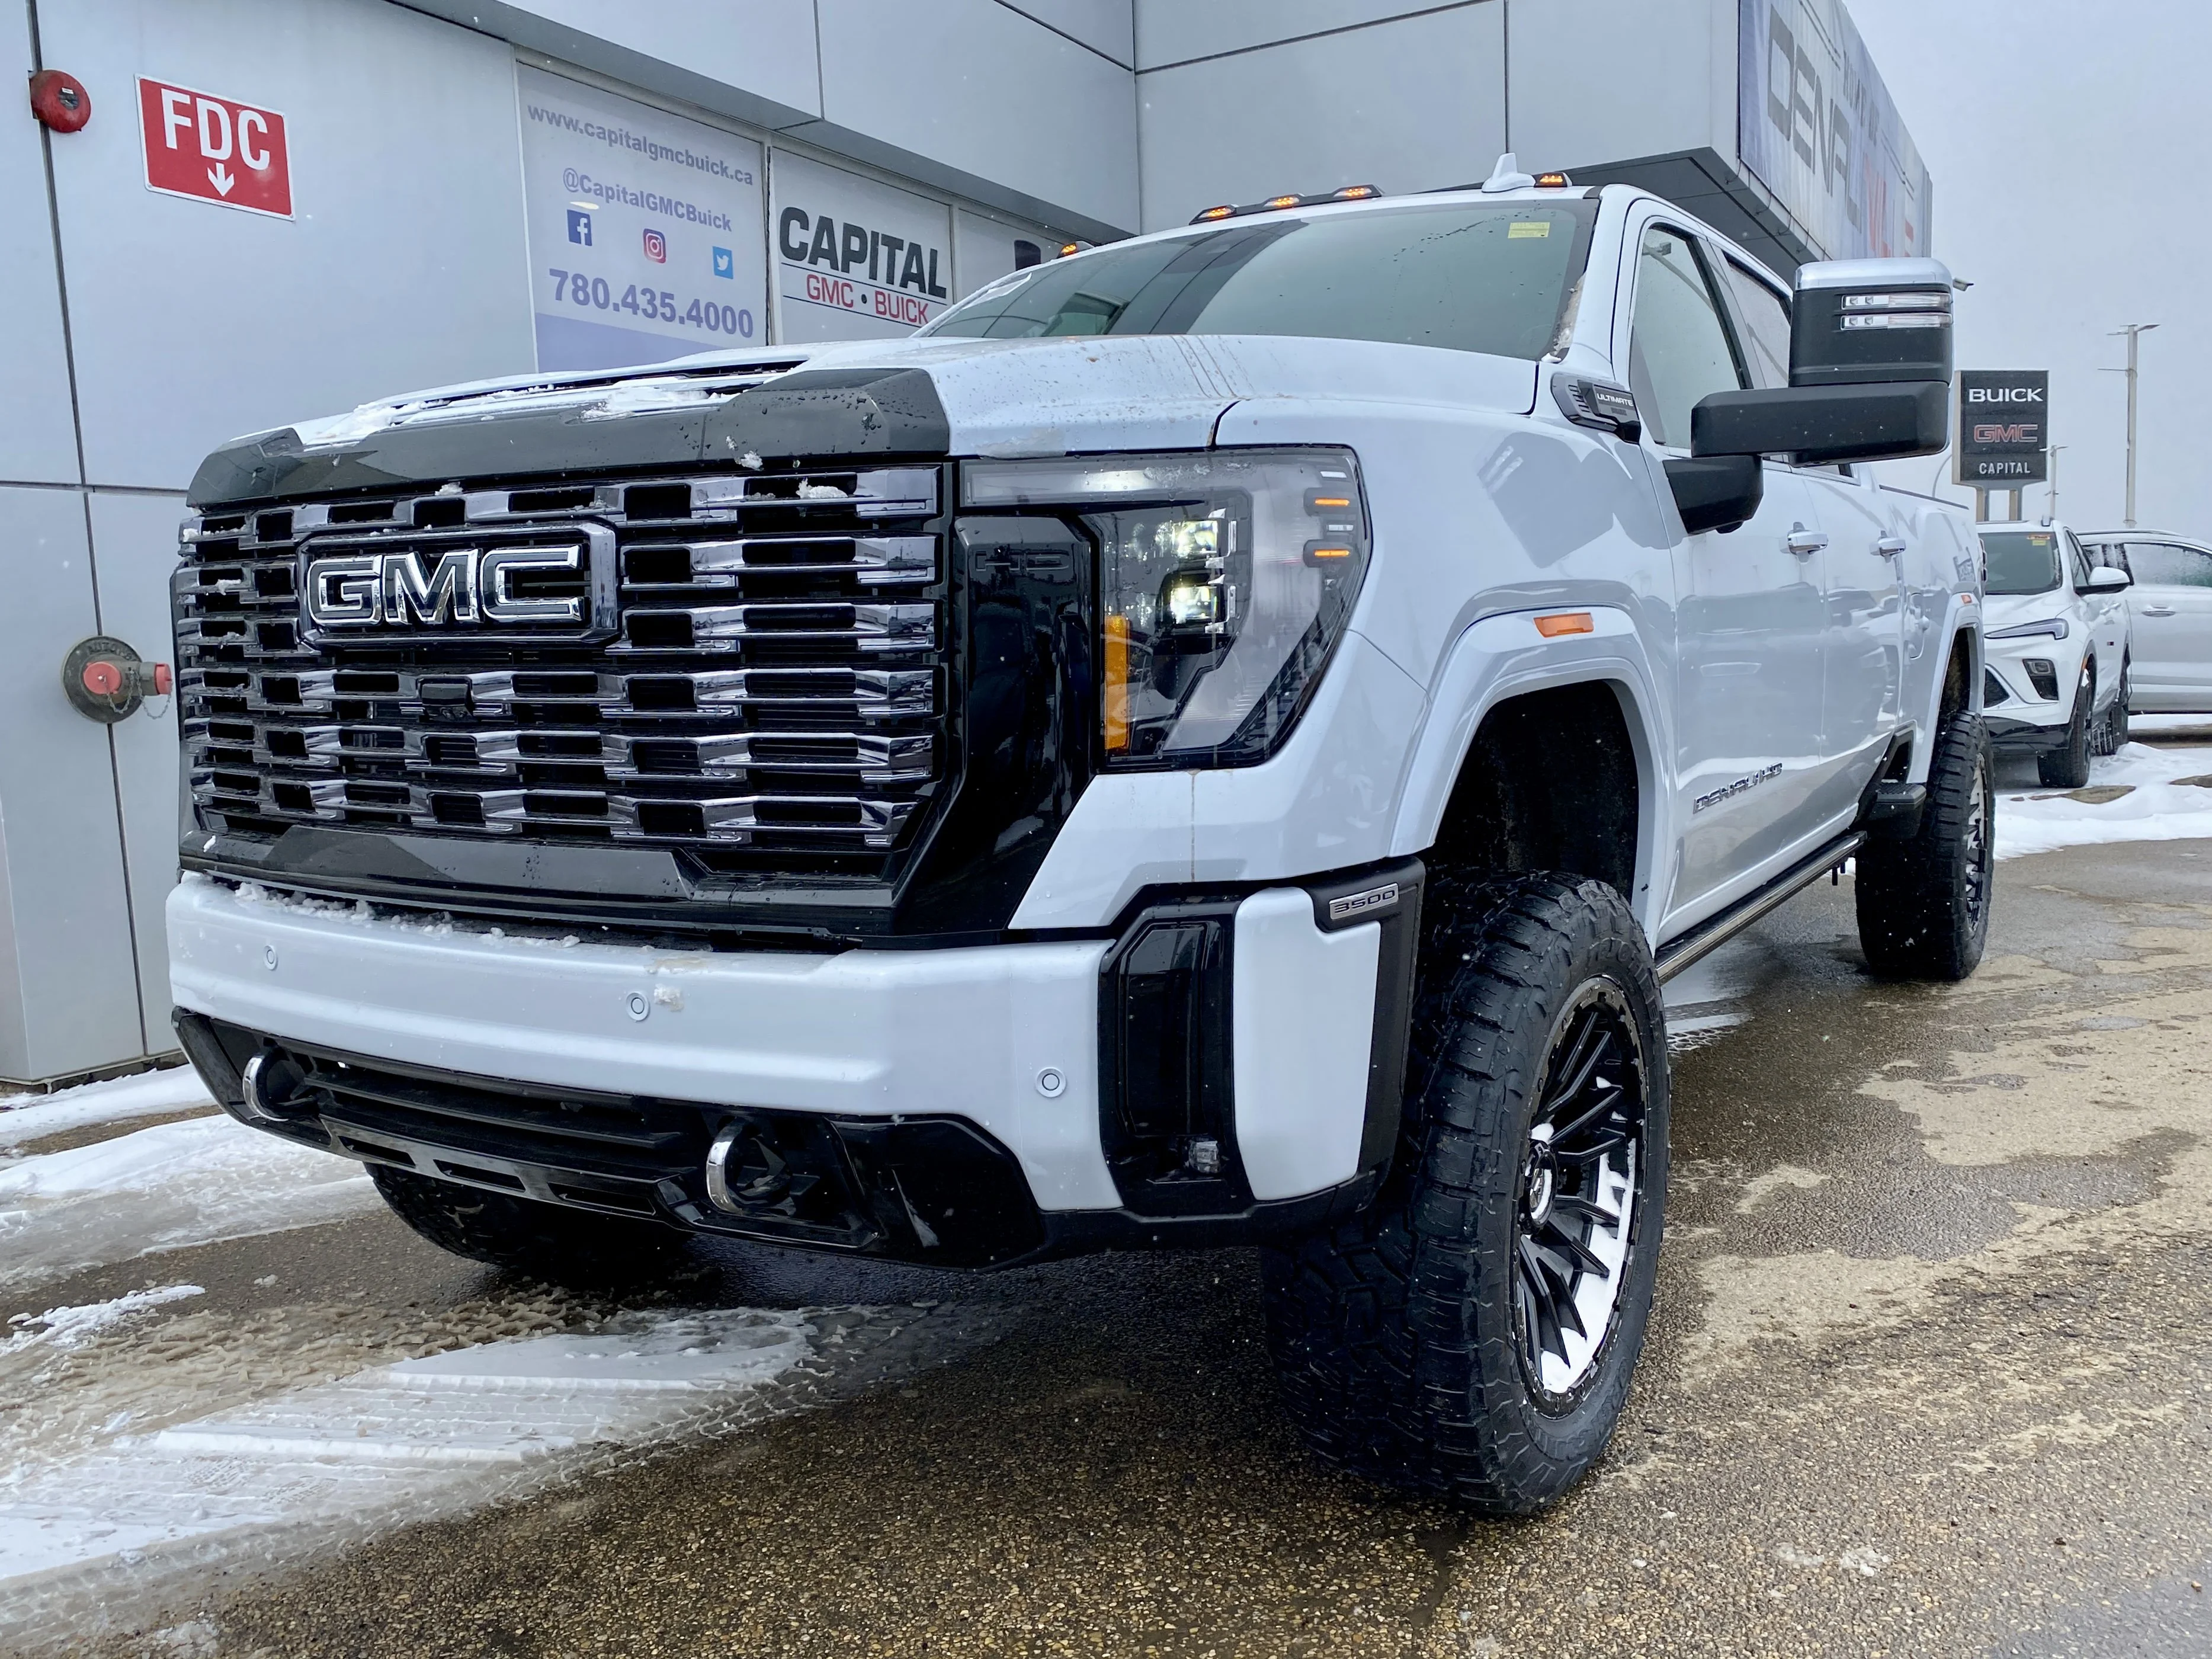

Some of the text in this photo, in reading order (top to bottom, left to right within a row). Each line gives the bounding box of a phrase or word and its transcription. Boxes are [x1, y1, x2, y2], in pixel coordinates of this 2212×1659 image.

[161, 88, 270, 171] FDC
[528, 105, 753, 185] www.capitalgmcbuick.ca
[563, 167, 732, 232] @CapitalGMCBuick
[780, 206, 947, 299] CAPITAL
[549, 268, 753, 338] 780.435.4000
[806, 274, 929, 324] GMC BUICK
[1597, 393, 1634, 406] ULTIMATE
[1969, 388, 2043, 403] BUICK
[1973, 424, 2038, 443] GMC
[1979, 462, 2031, 475] CAPITAL
[307, 545, 584, 626] GMC
[1692, 771, 1759, 814] DENALI
[1334, 889, 1395, 913] 3500
